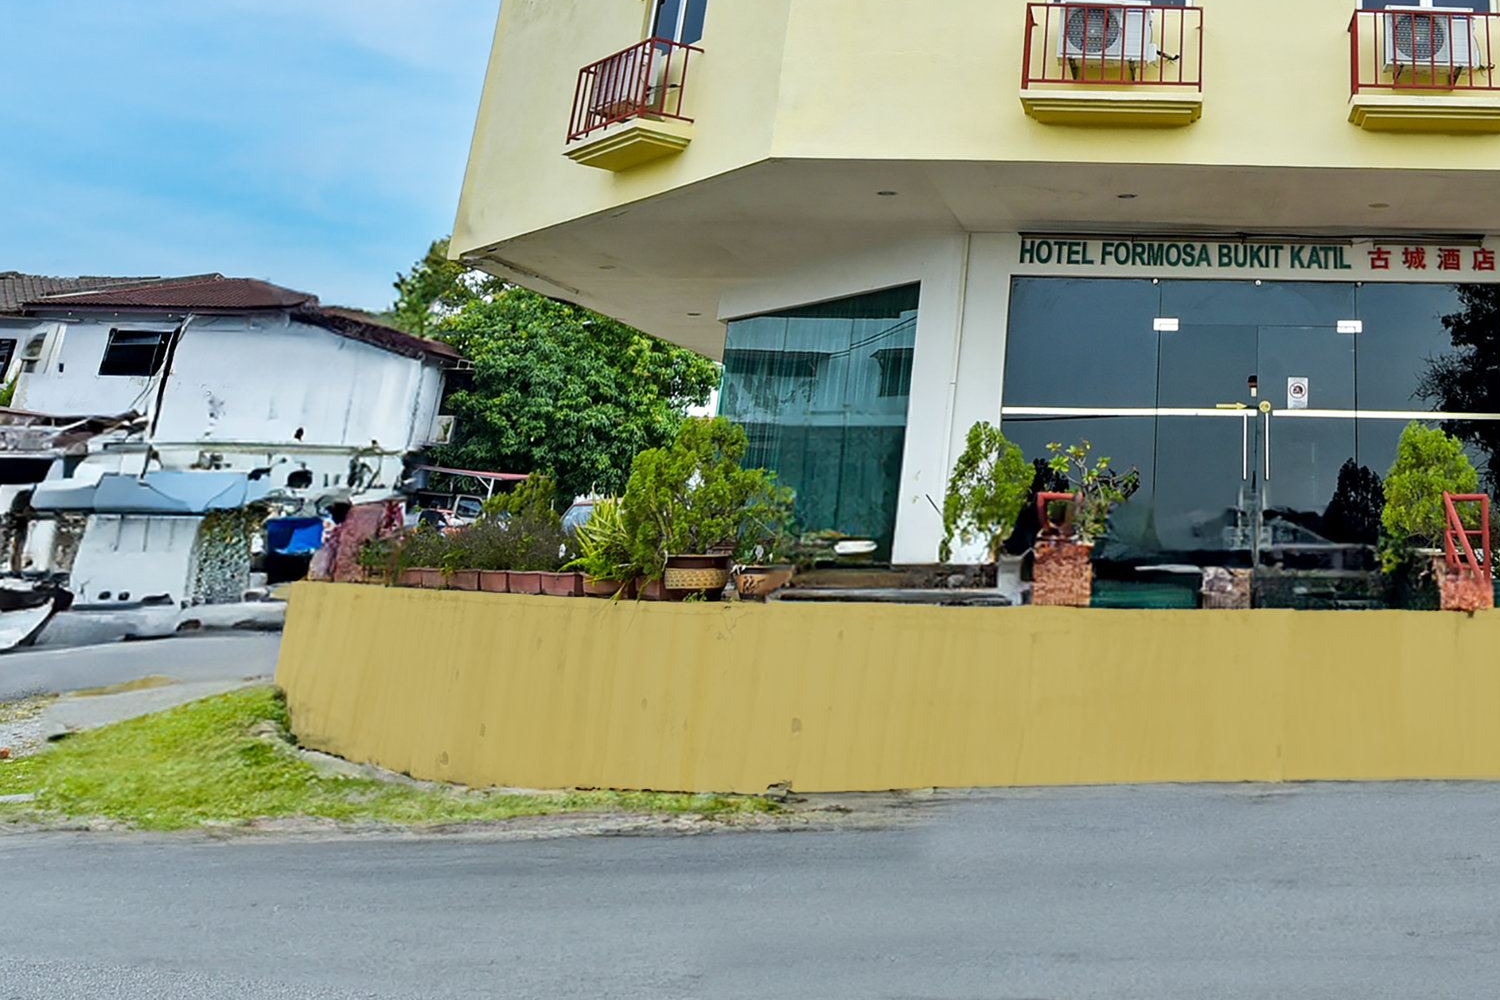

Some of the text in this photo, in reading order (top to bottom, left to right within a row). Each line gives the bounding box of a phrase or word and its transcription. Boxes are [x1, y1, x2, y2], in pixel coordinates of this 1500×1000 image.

[1019, 240, 1352, 270] HOTEL FORMOSA BUKIT KATIL
[1367, 247, 1496, 272] 古城酒店
